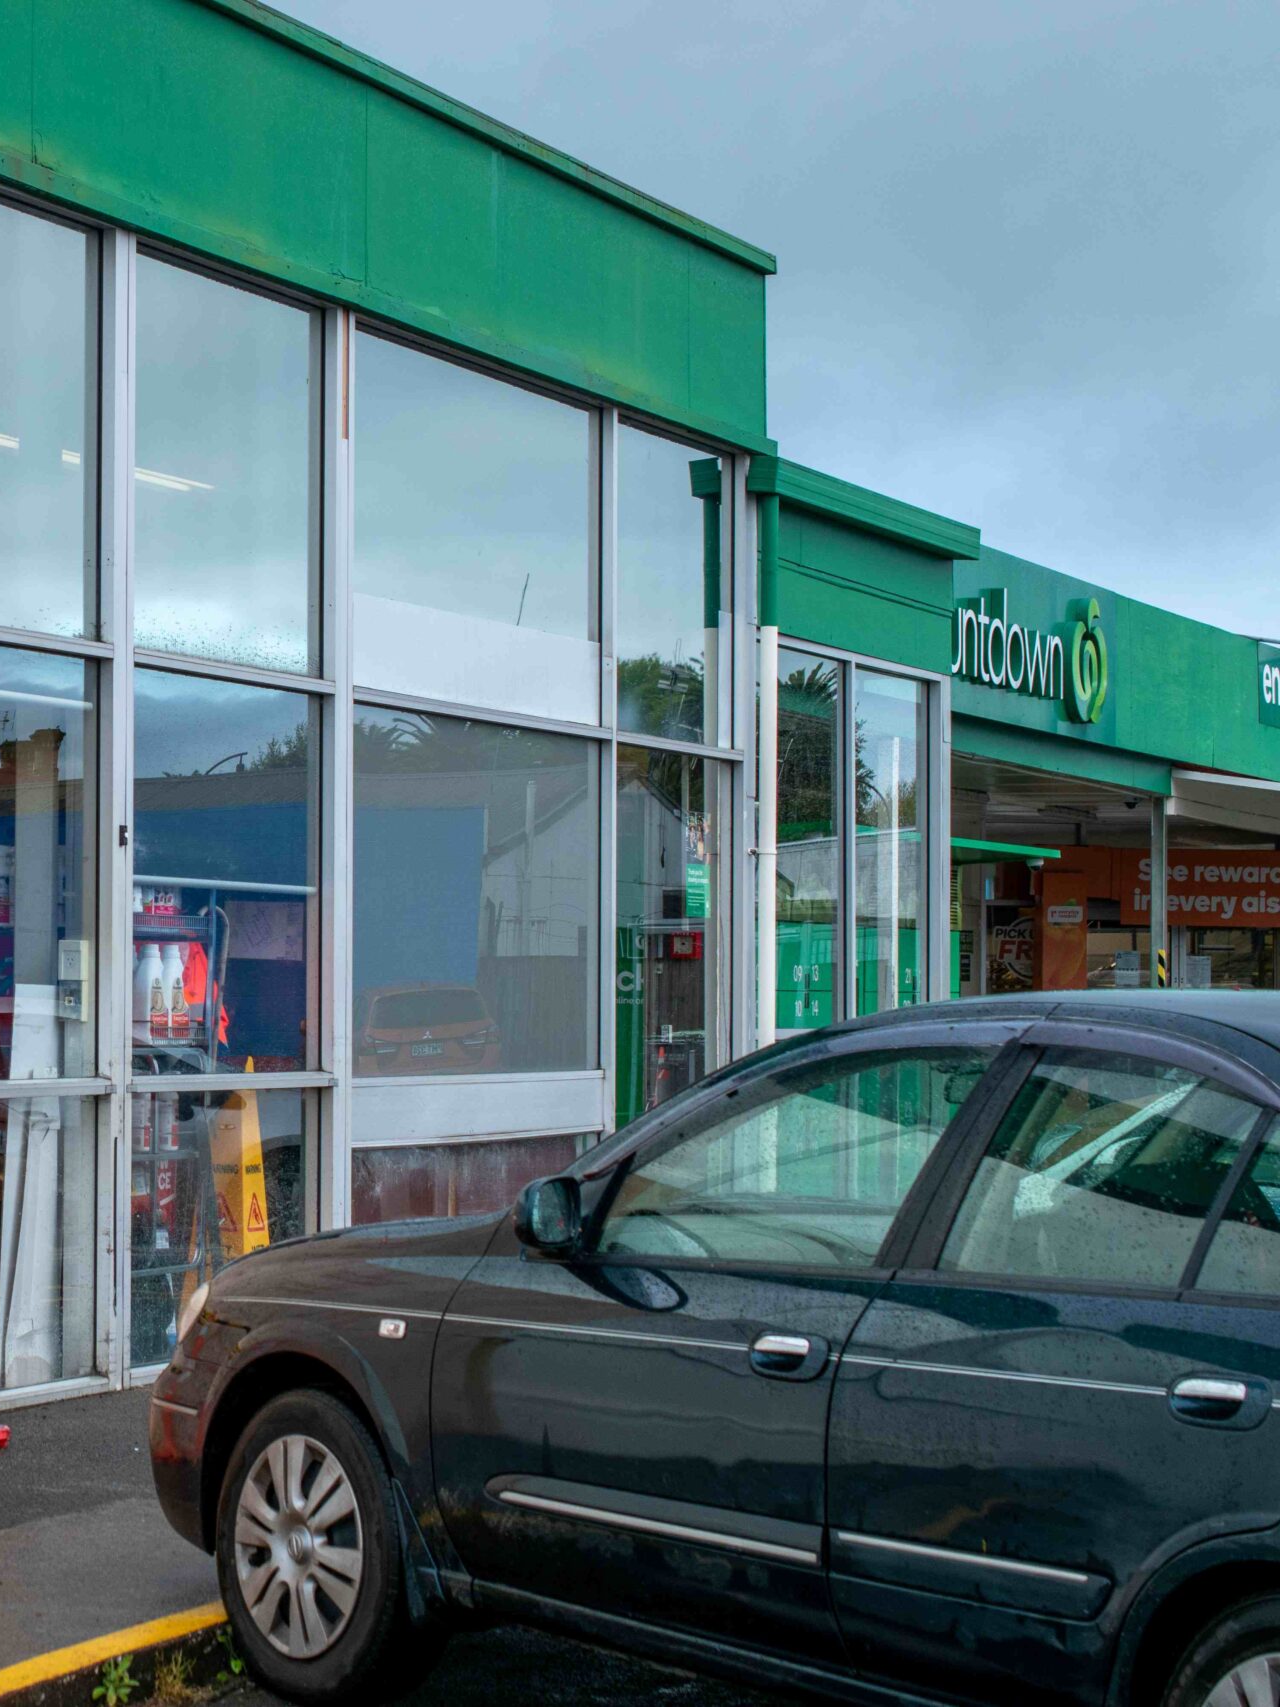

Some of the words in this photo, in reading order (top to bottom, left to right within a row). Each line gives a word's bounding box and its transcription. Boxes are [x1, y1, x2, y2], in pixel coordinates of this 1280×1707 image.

[1166, 893, 1238, 920] every
[994, 928, 1028, 940] PICK
[793, 964, 803, 982] 09
[794, 999, 803, 1017] 10
[811, 999, 819, 1017] 14
